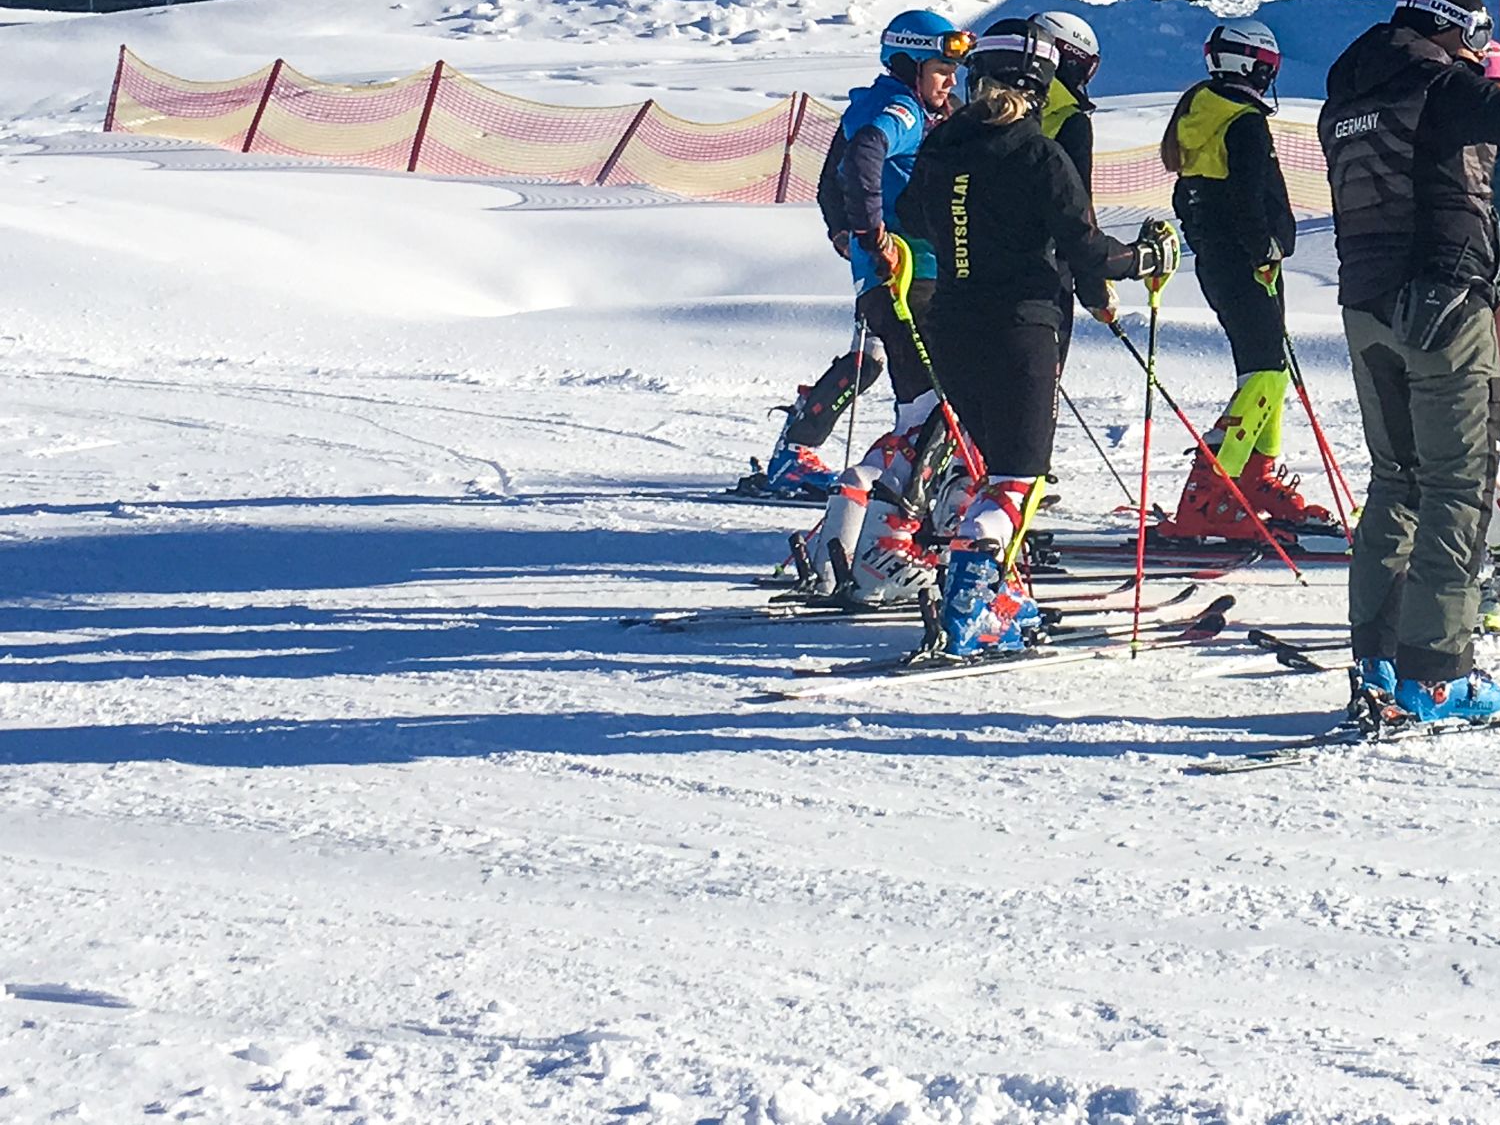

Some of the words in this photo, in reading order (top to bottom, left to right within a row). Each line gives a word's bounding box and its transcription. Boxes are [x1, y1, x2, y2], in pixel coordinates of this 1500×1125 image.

[1430, 0, 1467, 25] uvex
[895, 36, 932, 47] uvex
[1335, 111, 1380, 139] GERMANY
